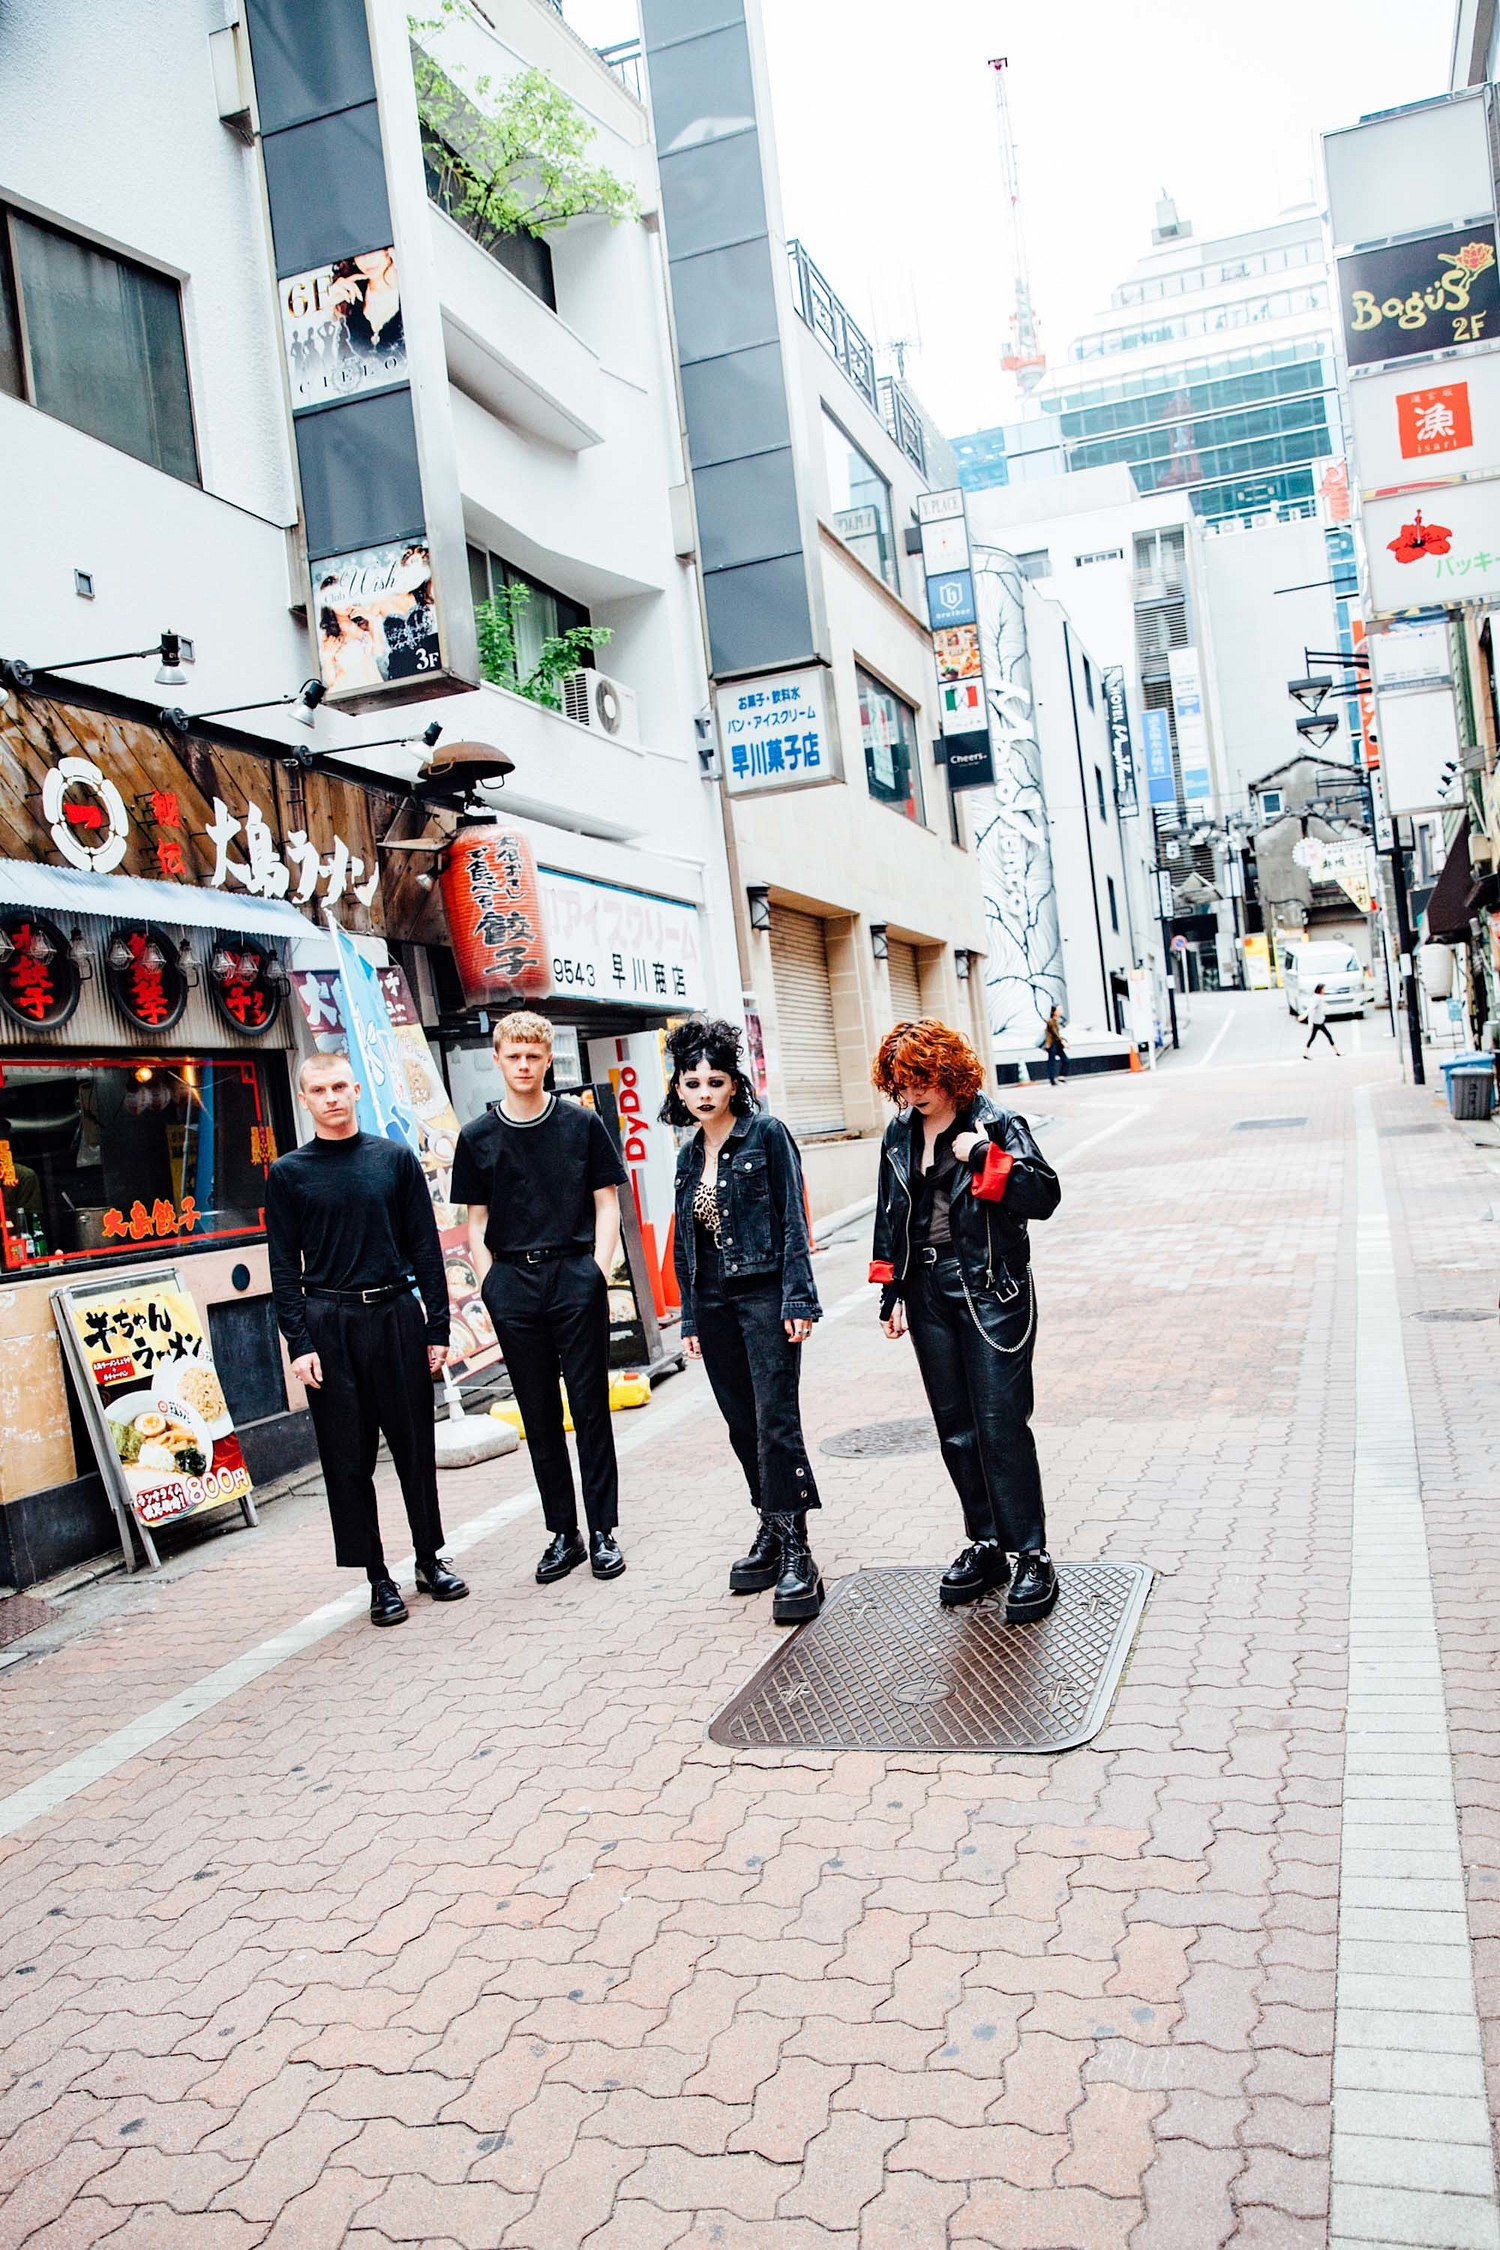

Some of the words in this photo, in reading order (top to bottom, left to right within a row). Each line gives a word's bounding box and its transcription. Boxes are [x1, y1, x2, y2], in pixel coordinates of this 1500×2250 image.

[287, 274, 334, 319] 6F
[1452, 310, 1487, 342] 2F
[299, 357, 398, 394] CIELO
[1413, 402, 1456, 442] 漁
[1416, 438, 1458, 453] isari
[340, 561, 398, 598] Wish
[415, 647, 439, 671] 3F
[738, 686, 801, 711] お菓子・飲料水
[1109, 683, 1124, 723] HOTEL
[727, 705, 816, 734] パン・アイスクリーム
[731, 731, 820, 780] 早川菓子店
[465, 846, 502, 910] で食べる
[495, 834, 526, 901] 大根おろし
[473, 909, 537, 977] 餃子
[553, 957, 596, 988] 9543
[611, 953, 687, 996] 早川商店
[83, 1302, 172, 1354] 半ちゃん
[131, 1332, 203, 1371] ラーメン
